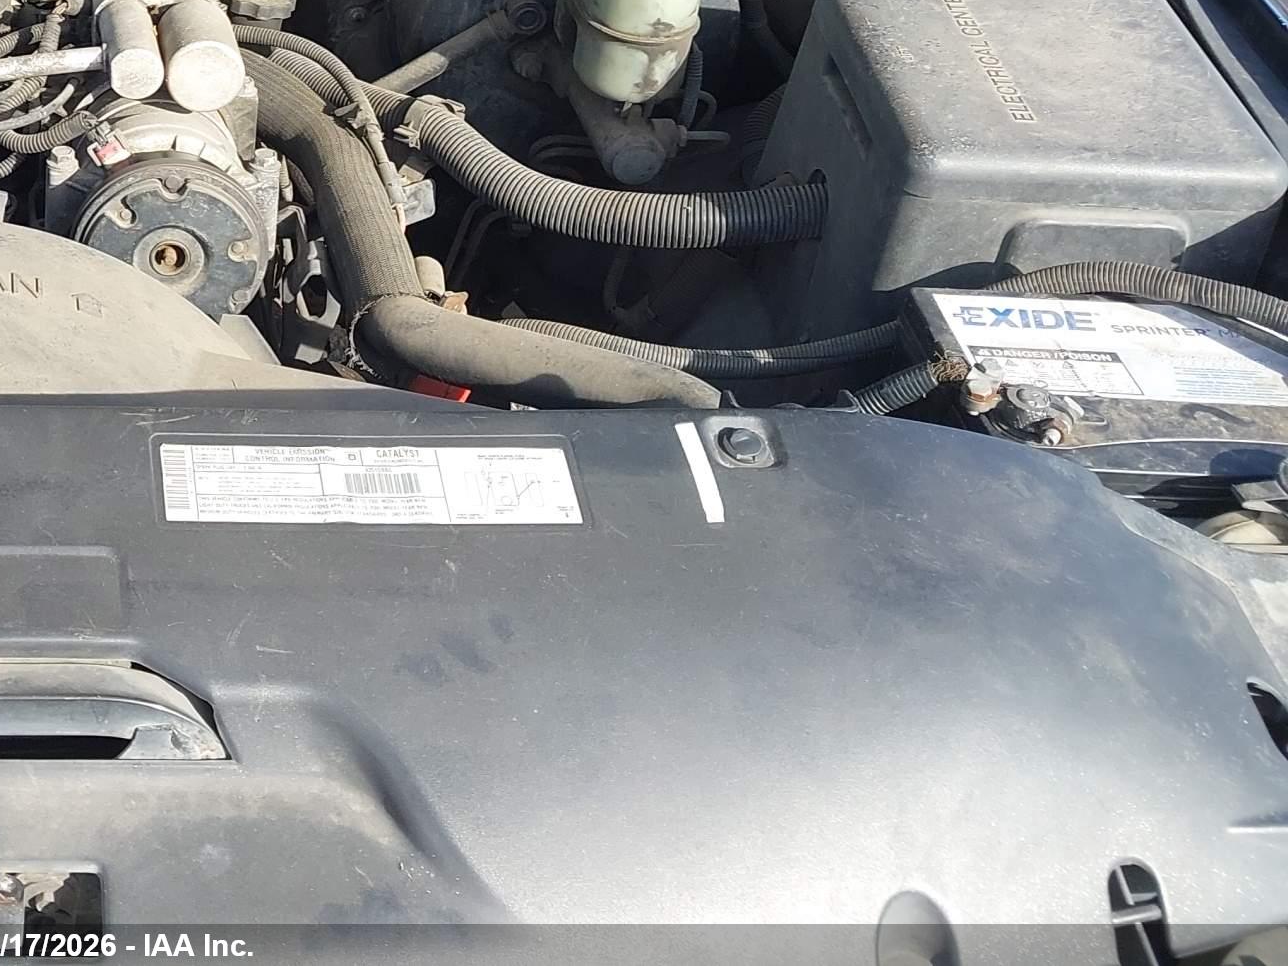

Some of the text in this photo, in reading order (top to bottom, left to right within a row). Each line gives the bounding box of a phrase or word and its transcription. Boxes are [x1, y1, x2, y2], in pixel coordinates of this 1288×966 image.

[971, 40, 1035, 122] ELECTRICAL
[952, 305, 1097, 332] EXIDE
[1111, 323, 1207, 338] SPRINTER
[992, 348, 1052, 361] DANGER
[255, 448, 286, 456] VEHICLE
[375, 448, 420, 459] CATALYST
